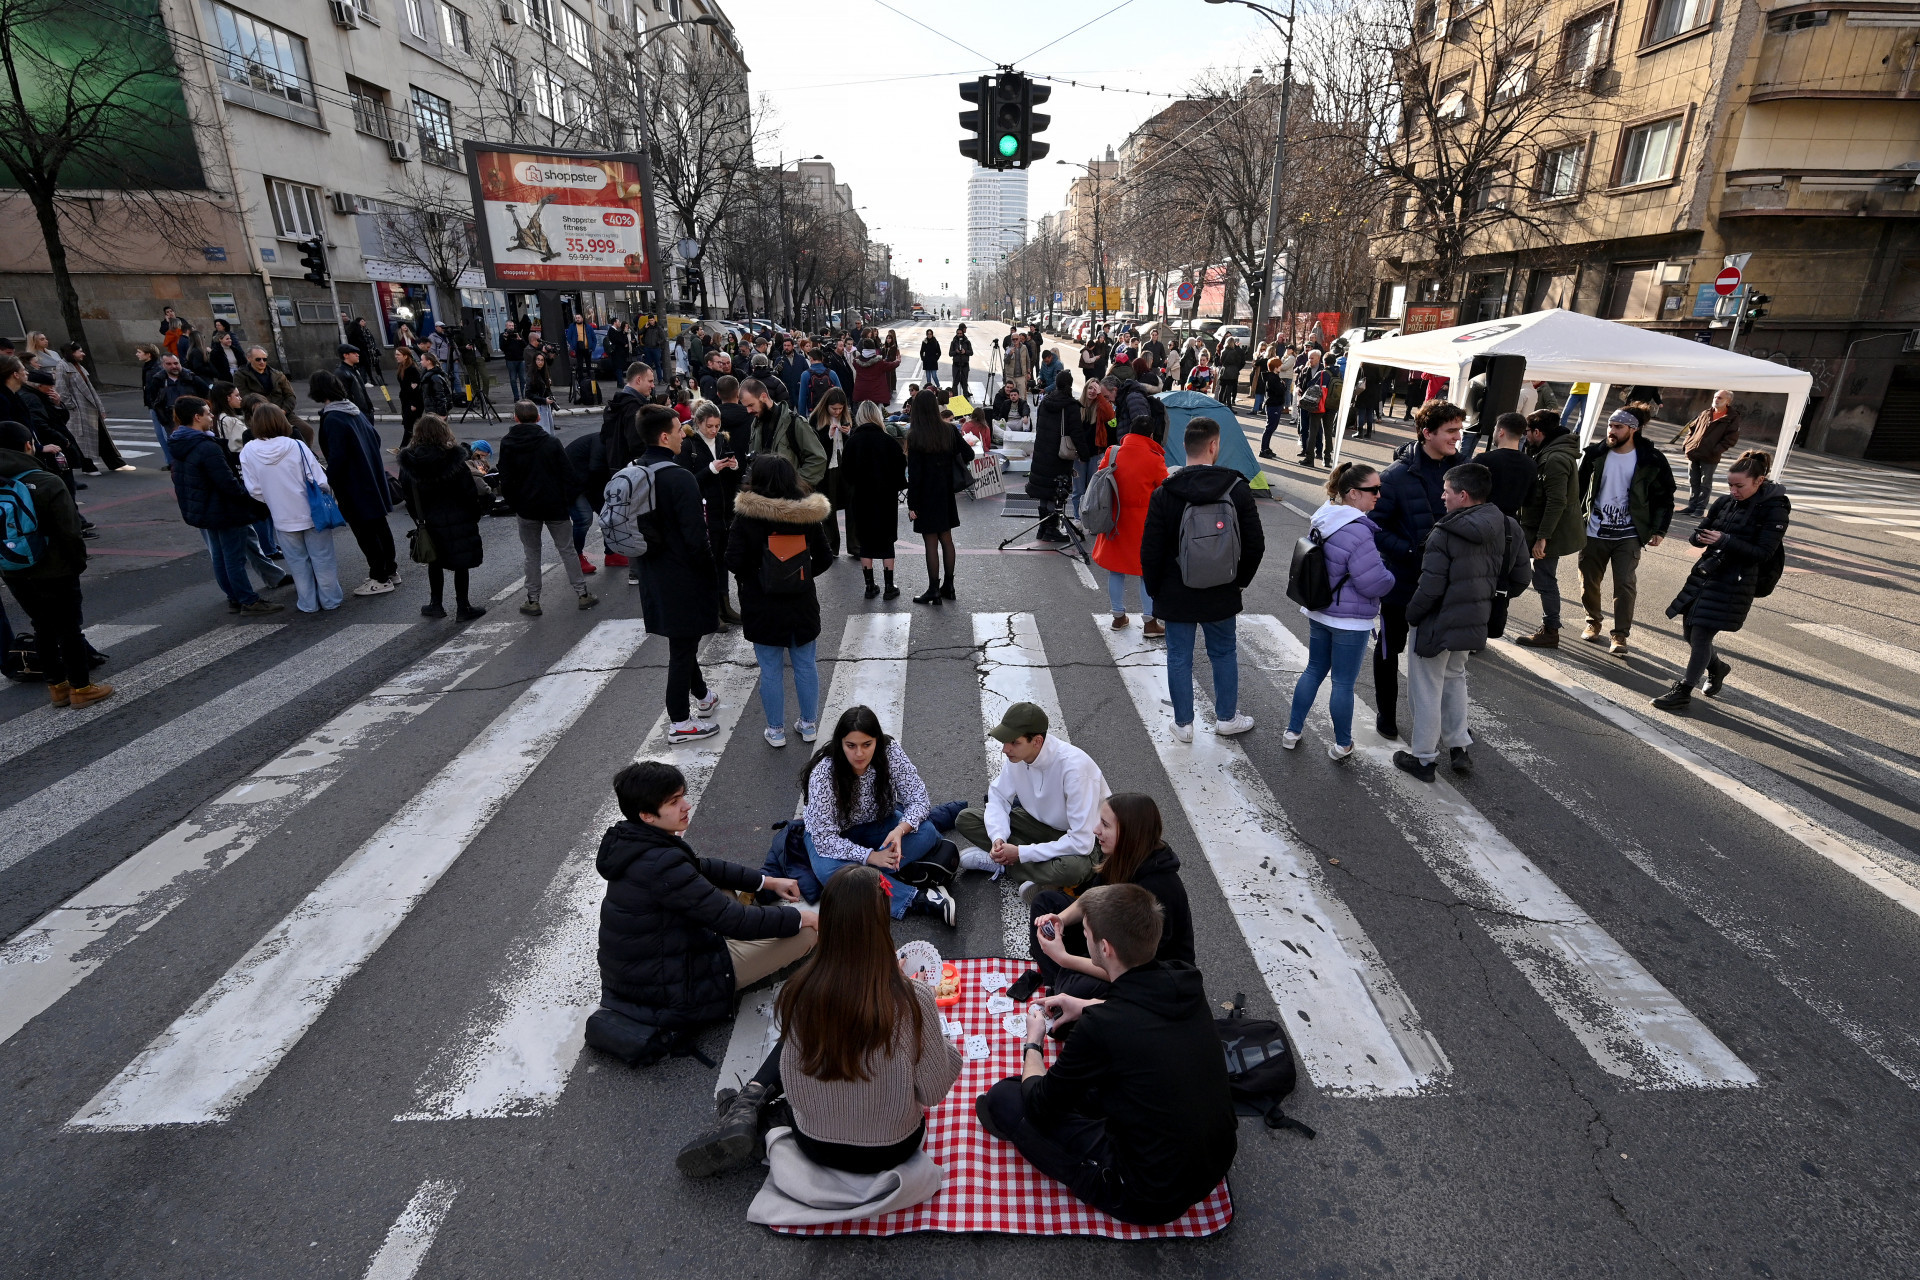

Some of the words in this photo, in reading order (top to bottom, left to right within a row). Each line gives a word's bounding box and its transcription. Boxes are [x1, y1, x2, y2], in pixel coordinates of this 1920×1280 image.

[544, 169, 598, 183] shoppster
[562, 215, 597, 225] Shoppster
[604, 216, 632, 226] -40%
[565, 237, 616, 254] 35.999
[1424, 313, 1436, 322] ŠTO
[1407, 322, 1436, 332] POŽELITE
